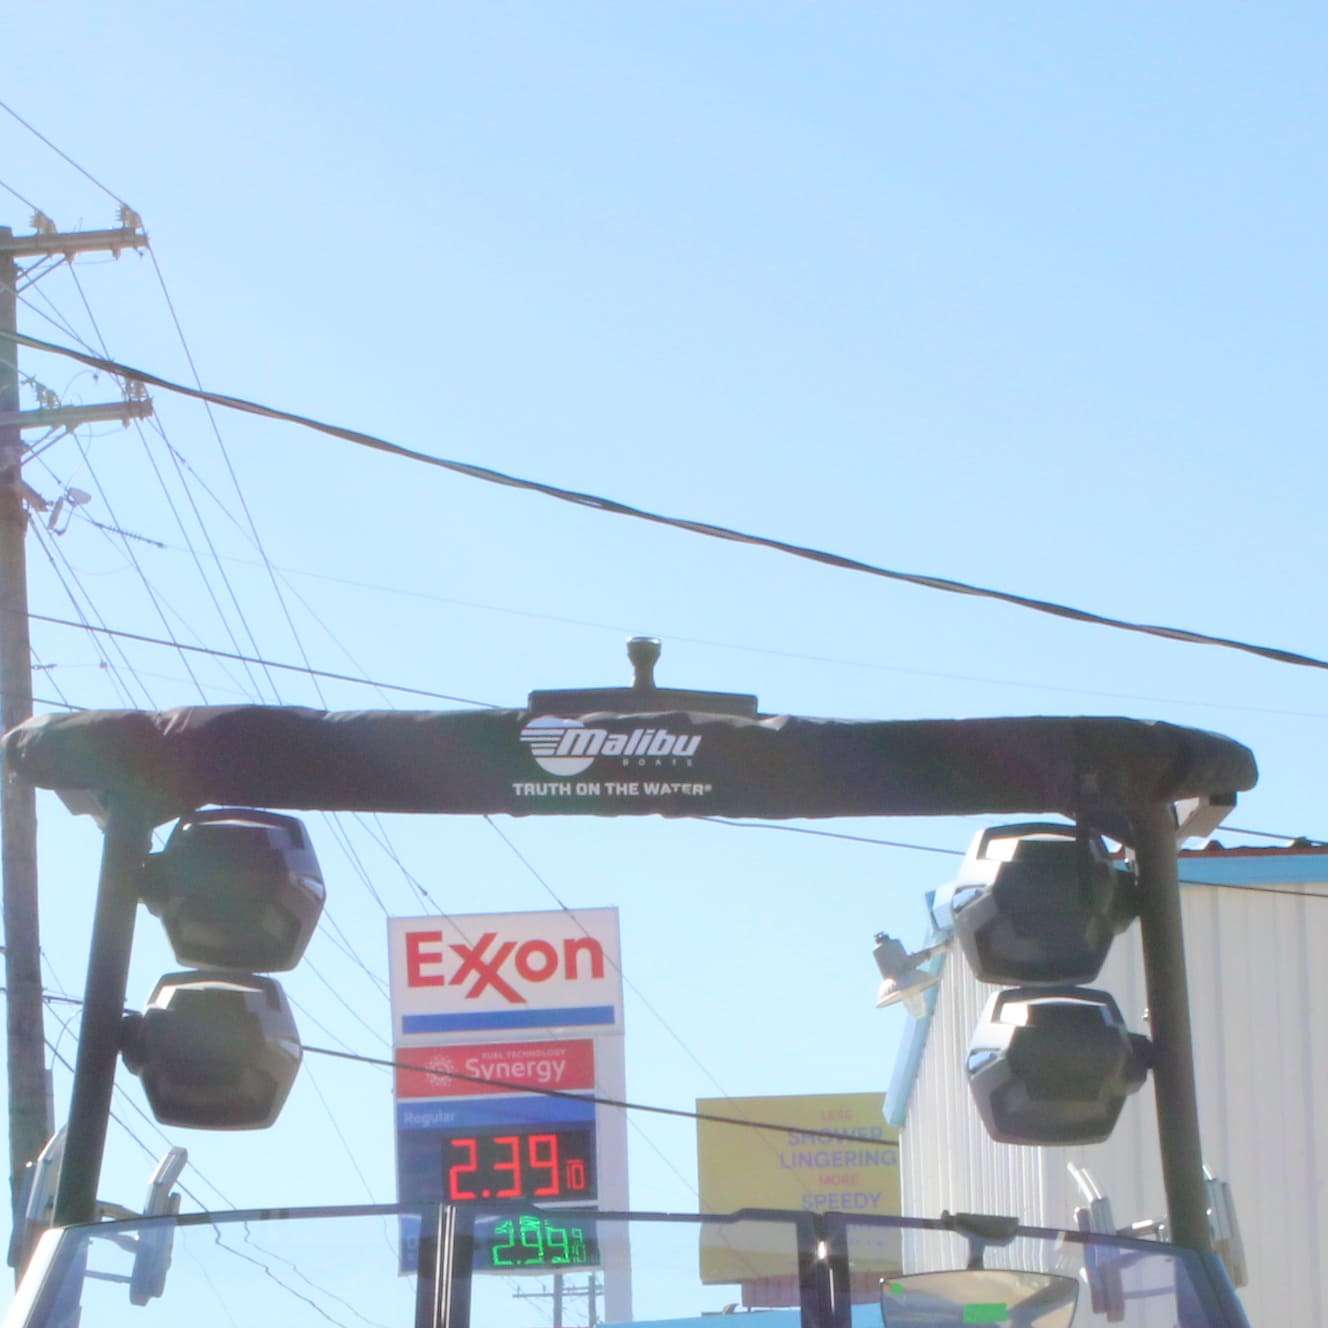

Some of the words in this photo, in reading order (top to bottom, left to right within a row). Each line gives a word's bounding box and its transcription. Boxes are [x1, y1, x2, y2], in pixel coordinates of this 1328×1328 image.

[557, 728, 702, 756] Malibu
[512, 782, 571, 796] TRUTH
[576, 782, 600, 796] ON
[604, 782, 639, 796] THE
[405, 929, 605, 1004] Exxon
[464, 1058, 566, 1083] Synergy
[403, 1109, 455, 1126] Regular
[449, 1133, 561, 1200] 2.39
[779, 1150, 897, 1169] LINGERING
[801, 1192, 881, 1210] SPEEDY
